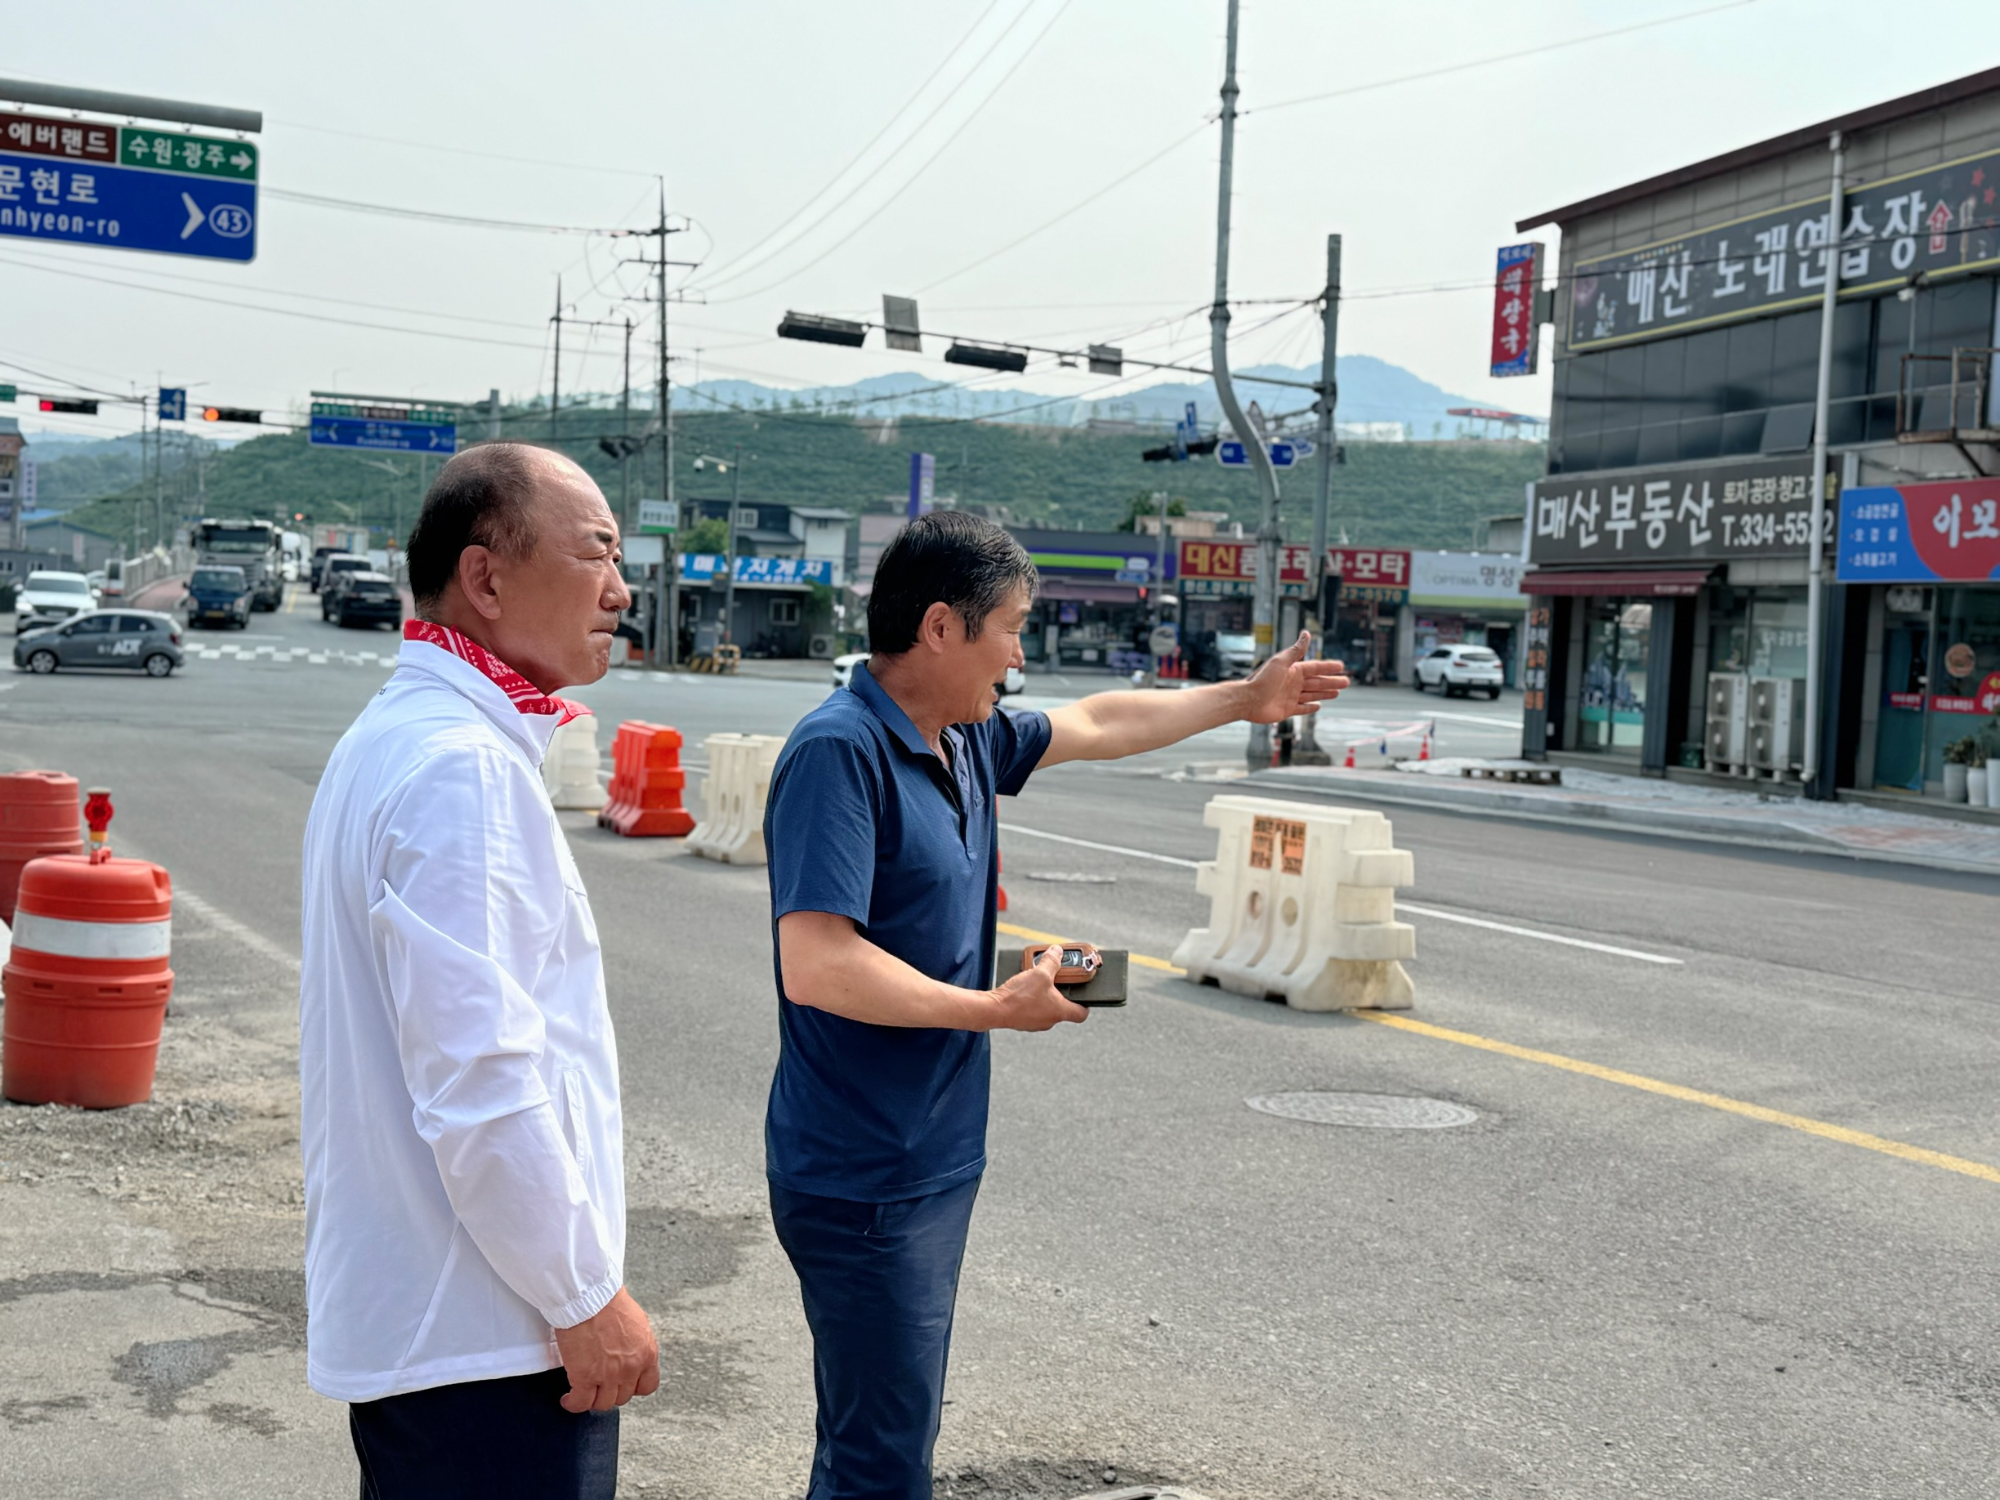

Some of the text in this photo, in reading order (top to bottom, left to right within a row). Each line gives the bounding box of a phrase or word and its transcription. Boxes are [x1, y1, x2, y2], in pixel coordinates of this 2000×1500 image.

[128, 135, 226, 168] 수원·광주
[0, 165, 99, 205] 문현로
[215, 209, 244, 233] 43
[1626, 250, 1695, 325] 매산
[1712, 190, 1928, 299] 노래연습장
[1537, 480, 1714, 550] 매산부동산
[1721, 508, 1835, 547] T.334-552
[1480, 564, 1516, 588] 명성
